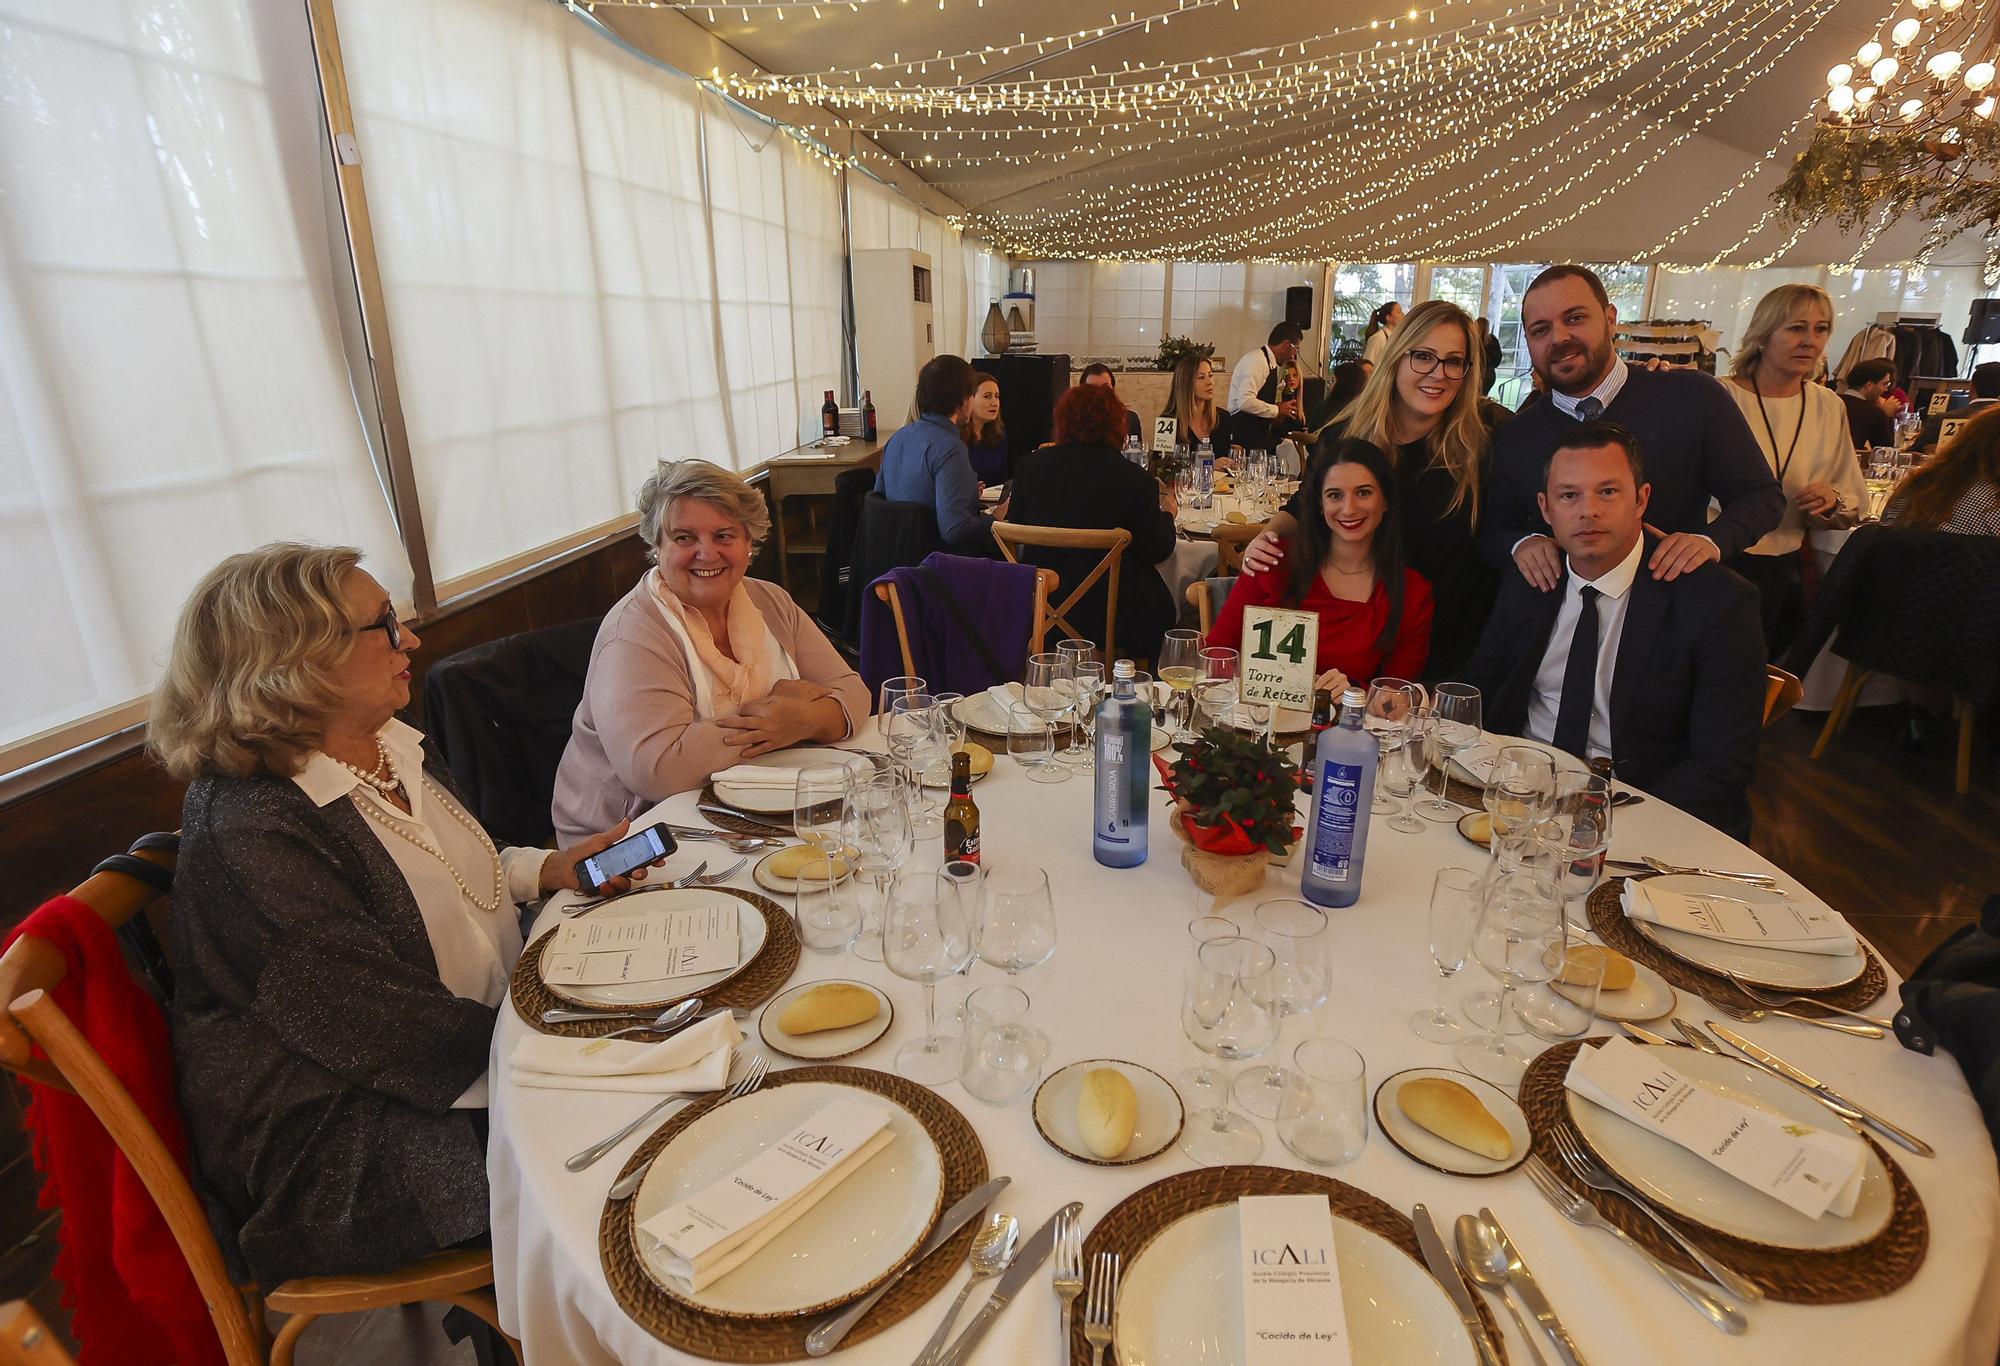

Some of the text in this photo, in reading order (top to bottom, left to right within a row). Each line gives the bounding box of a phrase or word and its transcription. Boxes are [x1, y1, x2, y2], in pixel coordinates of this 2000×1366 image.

[1933, 396, 1947, 406] 27
[1157, 420, 1174, 434] 24
[1944, 422, 1965, 437] 2
[1250, 619, 1307, 664] 14
[1248, 668, 1283, 683] Torre
[1246, 686, 1307, 703] de Reixes
[1633, 1071, 1677, 1111] ICALI
[1731, 1129, 1740, 1139] de
[793, 1131, 844, 1159] ICALI
[753, 1188, 763, 1196] de
[1252, 1243, 1327, 1265] ICALI
[1256, 1332, 1296, 1340] "Cocido
[1299, 1332, 1312, 1340] de
